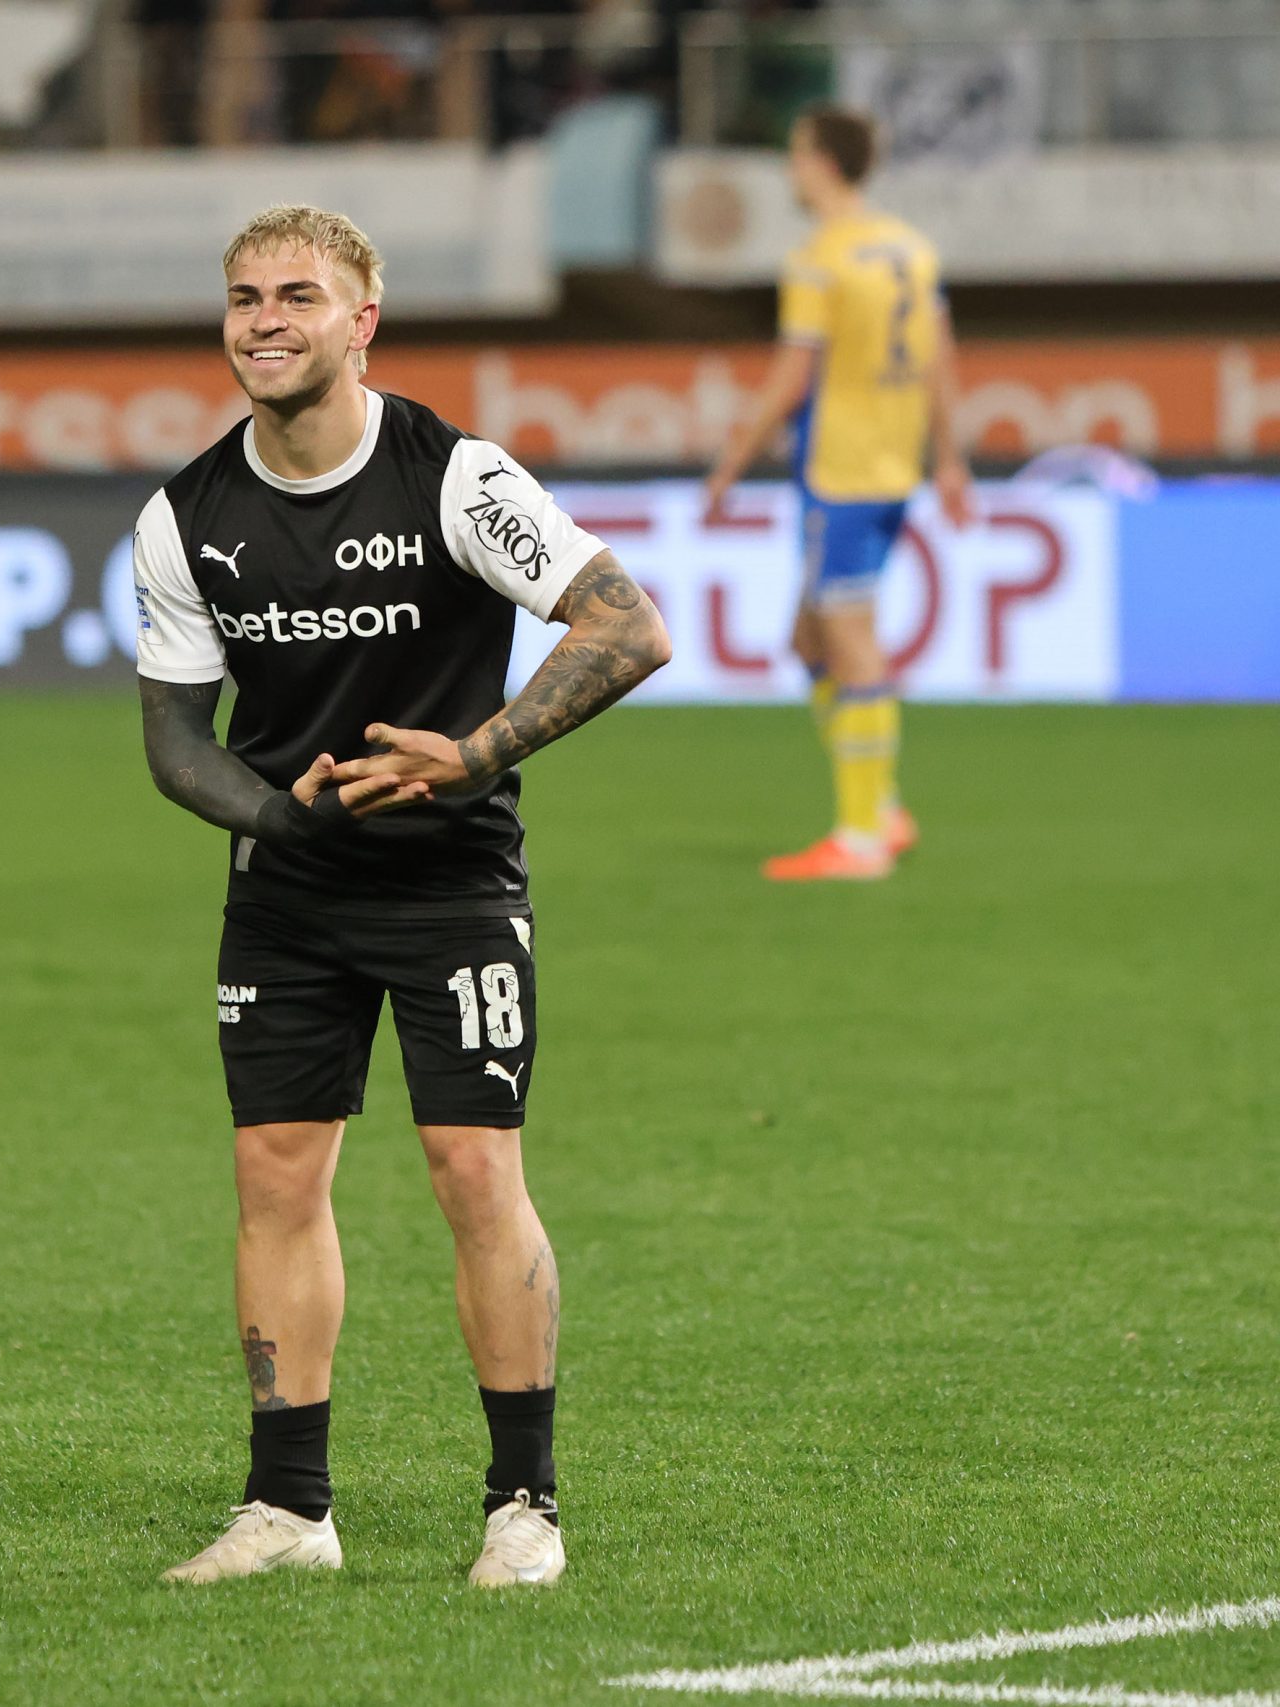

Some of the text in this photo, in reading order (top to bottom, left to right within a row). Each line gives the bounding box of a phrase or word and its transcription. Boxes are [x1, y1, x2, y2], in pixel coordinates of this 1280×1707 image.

[462, 491, 551, 581] ZARO'S
[211, 602, 421, 643] betsson
[447, 962, 524, 1049] 18
